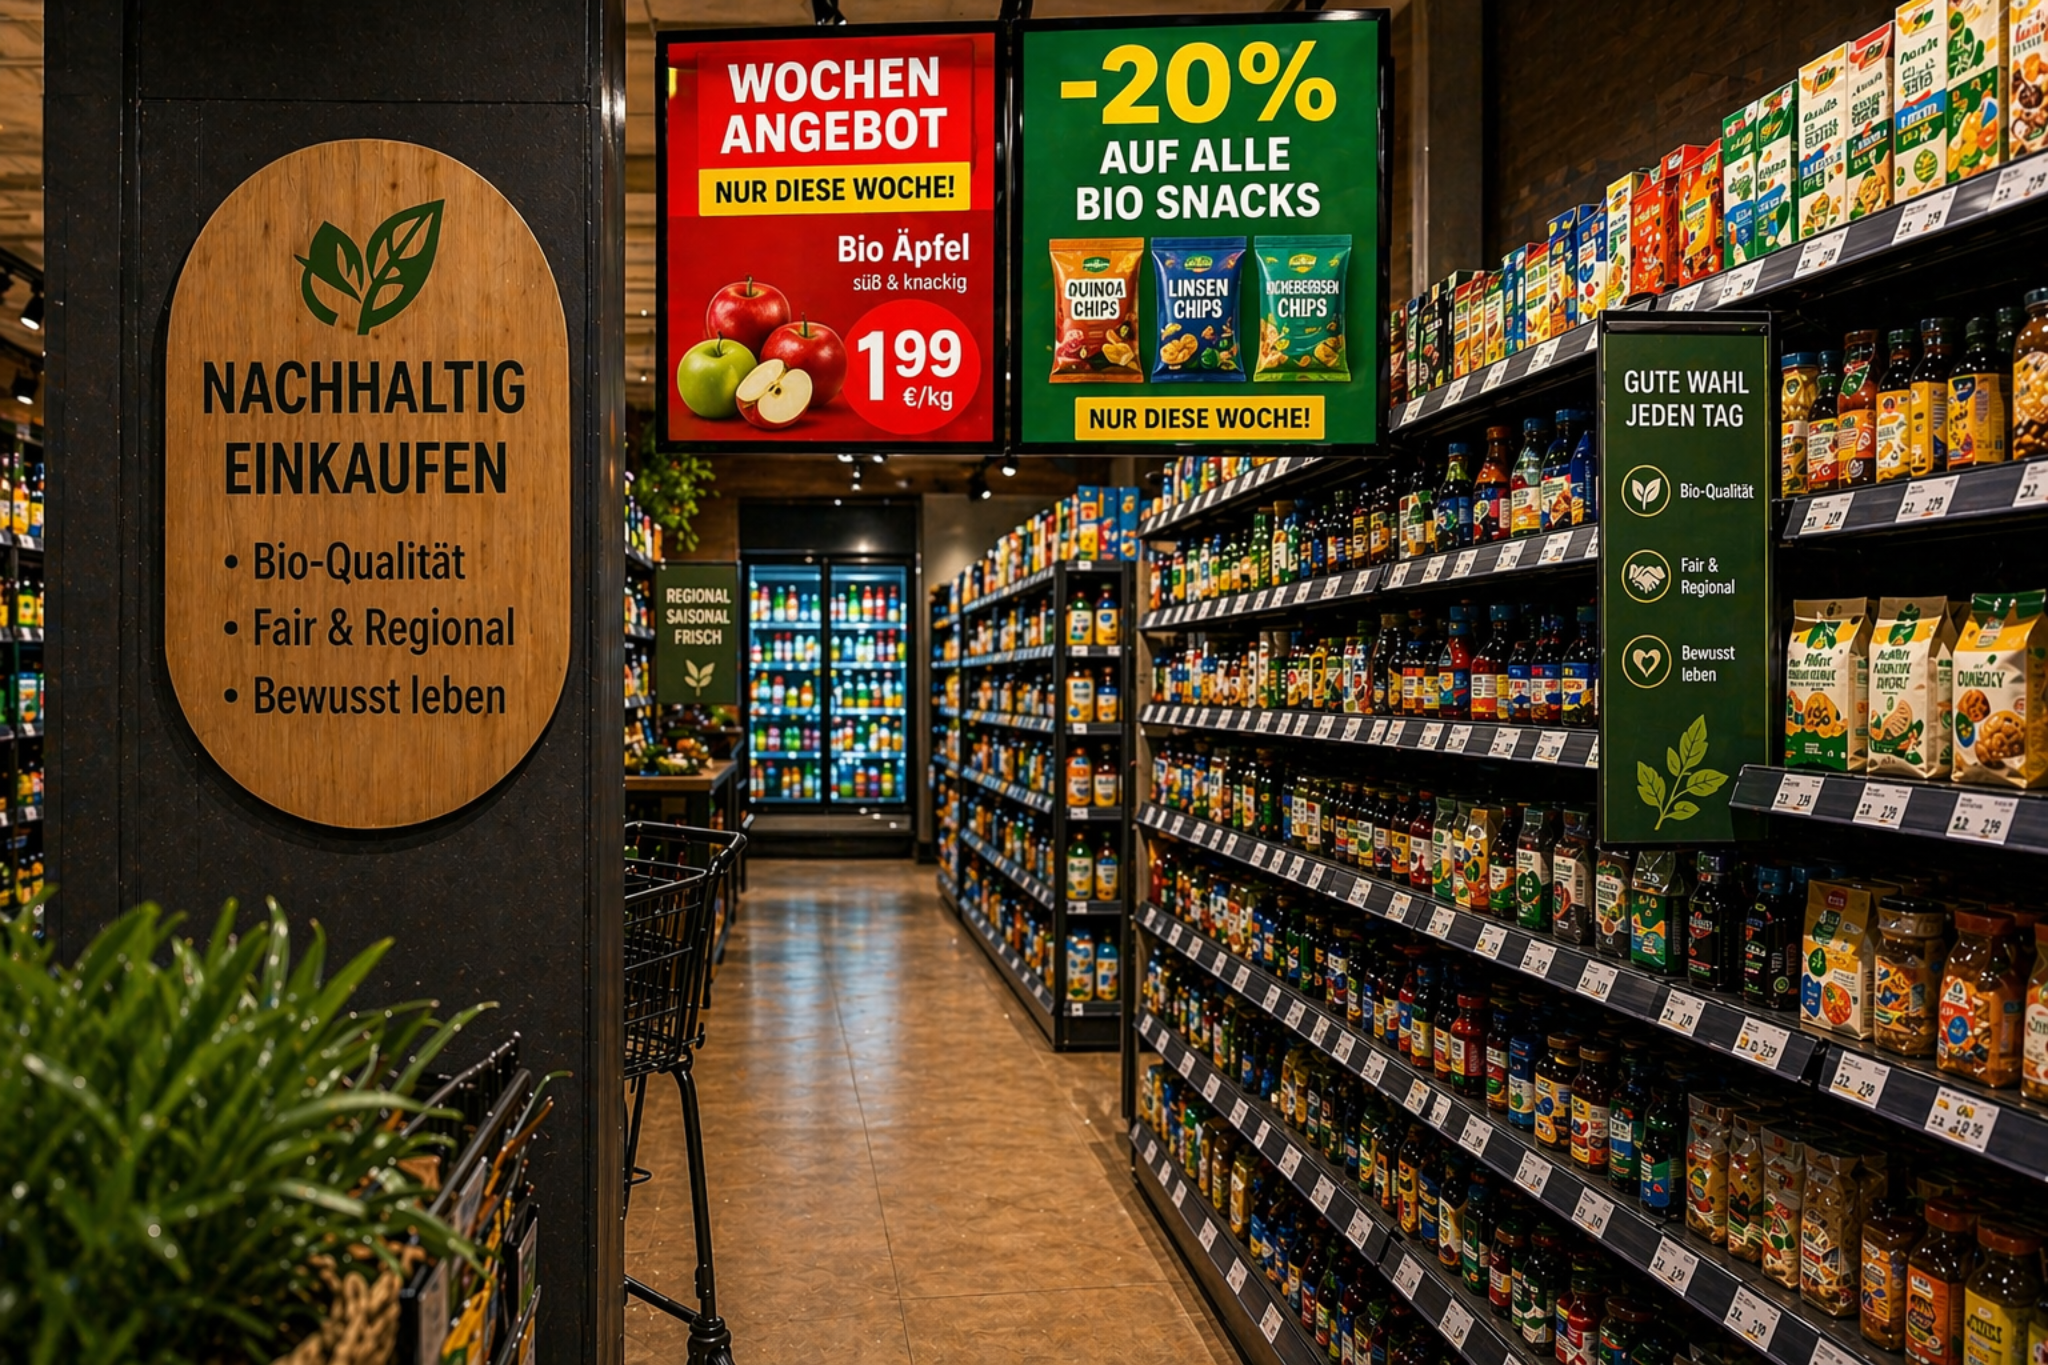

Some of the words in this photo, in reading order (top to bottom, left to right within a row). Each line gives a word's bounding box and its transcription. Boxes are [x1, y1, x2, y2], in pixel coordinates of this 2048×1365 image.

[727, 57, 939, 103] WOCHEN
[1060, 40, 1337, 125] -20%
[720, 107, 948, 154] ANGEBOT
[1100, 139, 1179, 174] AUF
[1191, 136, 1290, 173] ALLE
[715, 179, 768, 204] NUR
[775, 178, 846, 202] DIESE
[852, 175, 955, 201] WOCHE!
[1077, 185, 1143, 221] BIO
[1156, 182, 1320, 219] SNACKS
[838, 234, 884, 262] Bio
[893, 229, 969, 267] Äpfel
[853, 274, 882, 291] süß
[886, 274, 899, 290] &
[903, 274, 967, 294] knackig
[1169, 279, 1228, 297] LINSEN
[1074, 300, 1118, 317] CHIPS
[1174, 299, 1223, 319] CHIPS
[1278, 298, 1328, 317] CHIPS
[203, 360, 525, 414] NACHHALTIG
[1624, 369, 1681, 394] GUTE
[1687, 370, 1750, 394] WAHL
[902, 387, 953, 411] €/kg
[1089, 408, 1137, 430] NUR
[1144, 408, 1210, 429] DIESE
[1215, 407, 1310, 429] WOCHE!
[1625, 403, 1695, 427] JEDEN
[1703, 403, 1744, 427] TAG
[225, 442, 507, 494] EINKAUFEN
[1680, 482, 1754, 501] Bio-Qualität
[254, 540, 466, 584] Bio-Qualität
[1681, 557, 1705, 573] Fair
[1708, 557, 1719, 573] &
[666, 588, 731, 604] REGIONAL
[1681, 578, 1735, 598] Regional
[666, 609, 731, 624] SAISONAL
[254, 607, 319, 646] Fair
[328, 607, 354, 646] &
[366, 606, 515, 656] Regional
[674, 629, 722, 645] FRISCH
[1682, 644, 1736, 661] Bewusst
[1682, 666, 1717, 682] leben
[254, 676, 401, 715] Bewusst
[411, 674, 506, 715] leben
